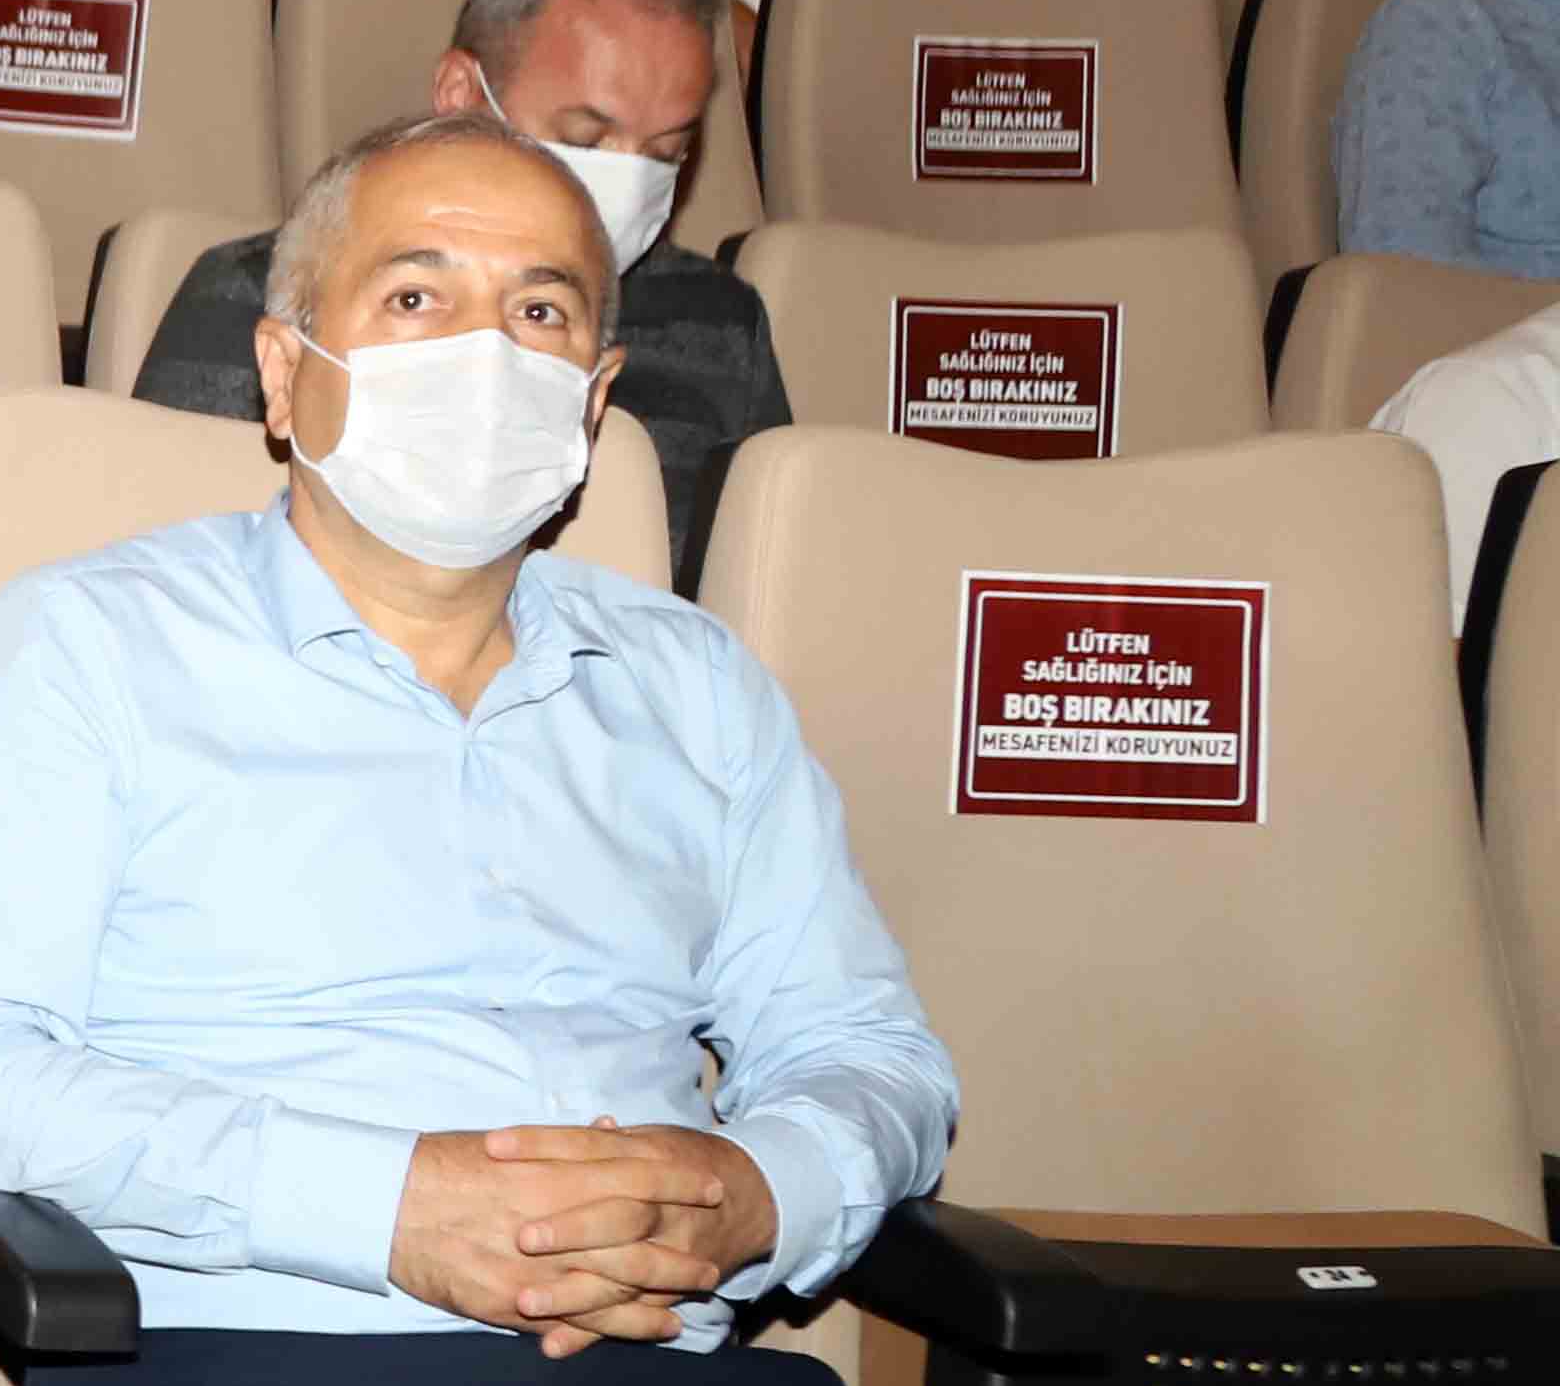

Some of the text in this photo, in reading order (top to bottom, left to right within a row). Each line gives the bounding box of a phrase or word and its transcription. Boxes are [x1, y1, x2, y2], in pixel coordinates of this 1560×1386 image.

[18, 7, 71, 26] LÜTFEN
[15, 47, 108, 71] BIRAKINIZ
[975, 111, 1063, 128] BIRAKINIZ
[970, 329, 1032, 351] LÜTFEN
[940, 351, 1064, 376] SAĞLIĞINIZ İÇİN
[926, 377, 1078, 405] BOŞ BIRAKINIZ
[909, 404, 1093, 425] MESAFENİZİ KORUYUNUZ
[1066, 628, 1151, 655] LÜTFEN
[1022, 656, 1192, 691] SAĞLIĞINIZ İÇİN
[1003, 693, 1211, 728] BOŞ BIRAKINIZ
[982, 731, 1233, 757] MESAFENİZİ KORUYUNUZ
